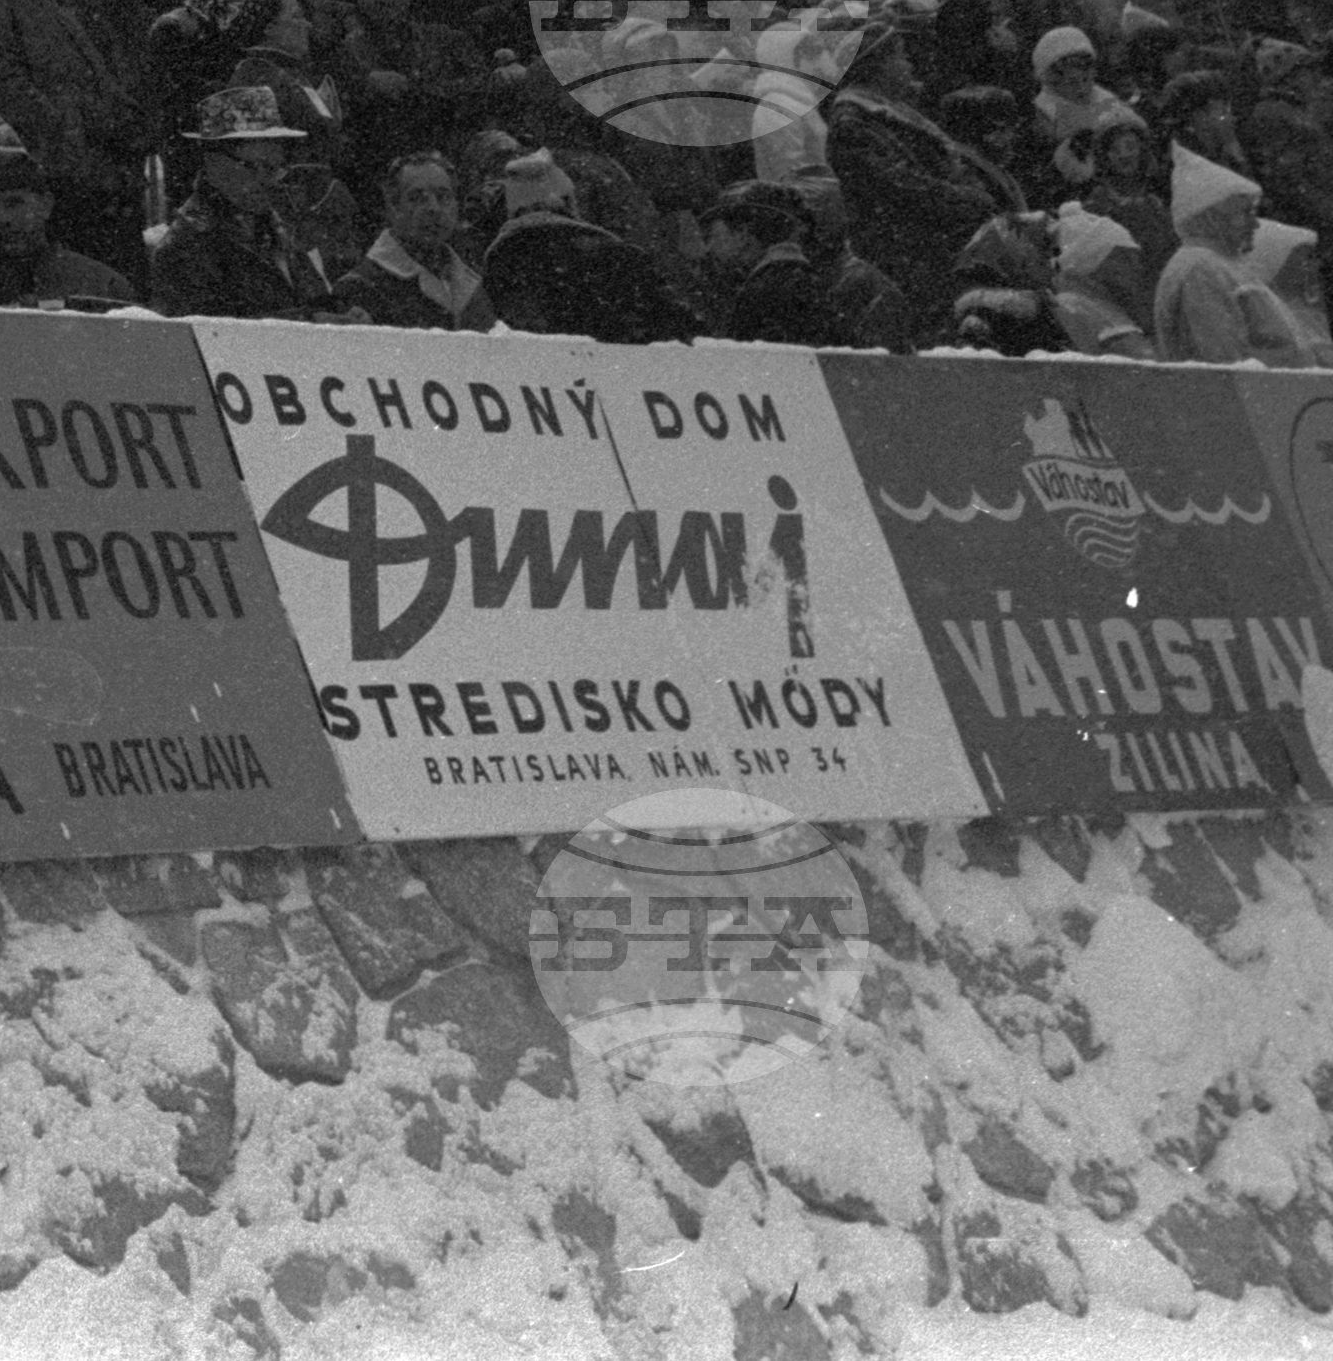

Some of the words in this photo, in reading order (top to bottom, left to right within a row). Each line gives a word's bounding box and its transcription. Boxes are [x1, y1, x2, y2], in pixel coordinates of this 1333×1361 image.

[214, 371, 599, 439] OBCHODNÝ
[642, 390, 786, 442] DOM
[319, 678, 691, 740] STREDISKO
[53, 734, 272, 798] BRATISLAVA
[648, 745, 721, 778] NÁM.
[734, 747, 791, 775] SNP
[811, 747, 848, 773] 34
